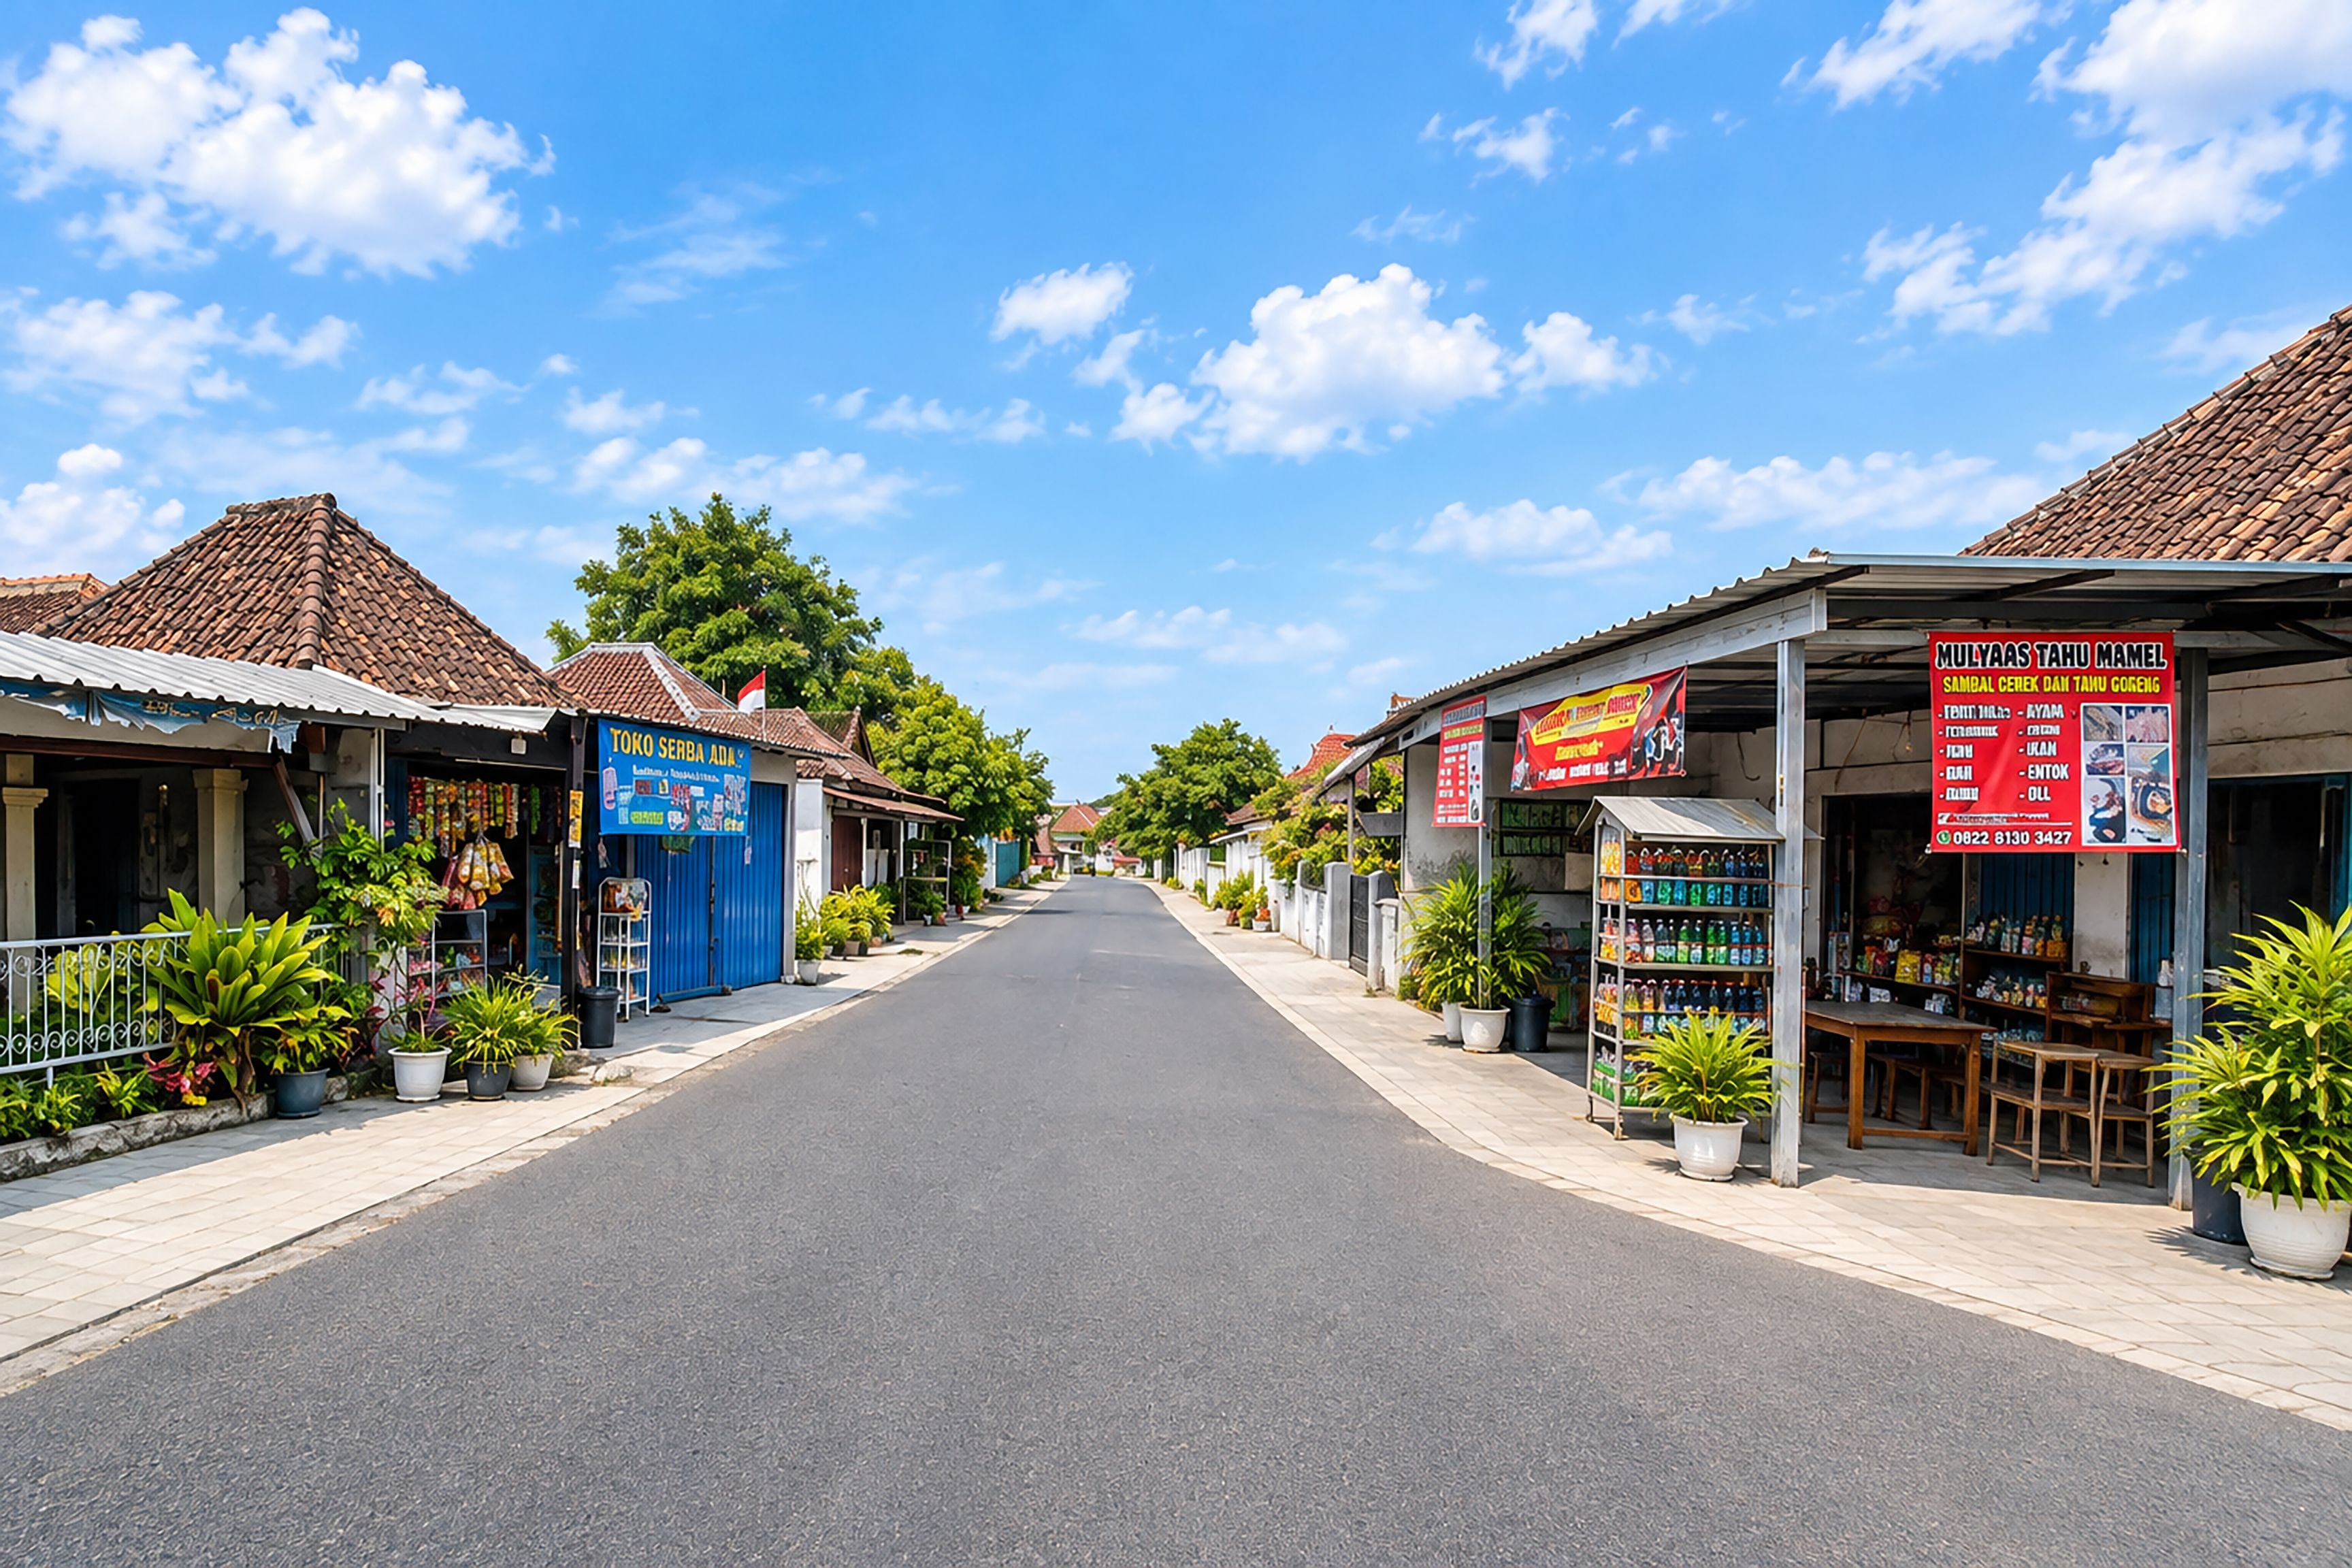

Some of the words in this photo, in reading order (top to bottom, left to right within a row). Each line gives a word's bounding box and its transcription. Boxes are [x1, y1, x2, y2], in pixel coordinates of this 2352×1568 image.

[1936, 641, 2031, 670] MULYAAS
[2034, 641, 2091, 670] TAHU
[1942, 675, 1995, 694] SAMBAL
[610, 728, 654, 757] TOKO
[657, 736, 704, 764] SERBA
[2027, 763, 2069, 781] ENTOK
[1953, 830, 1990, 845] 0822
[1994, 830, 2030, 845] 8130
[2034, 830, 2072, 845] 3427
